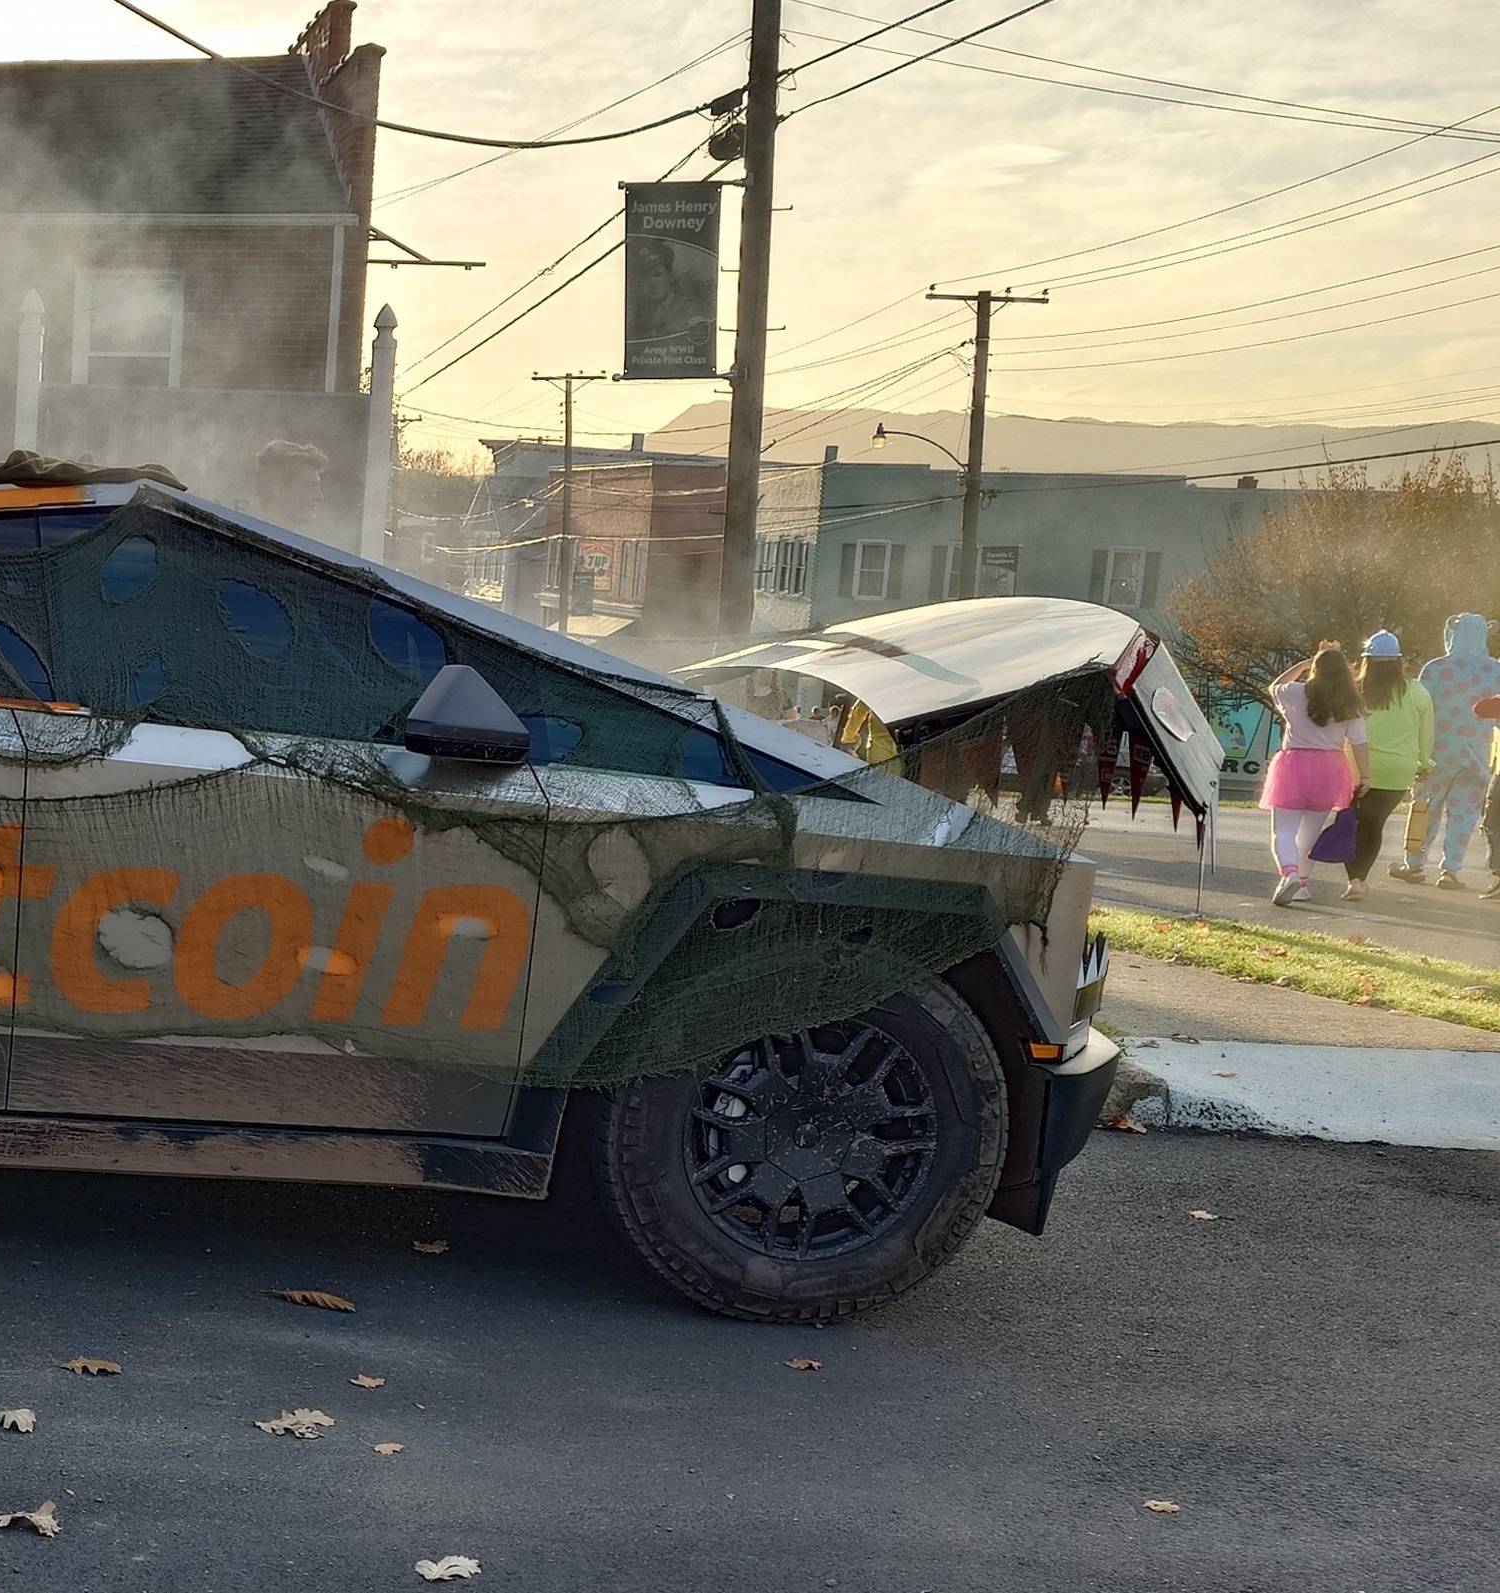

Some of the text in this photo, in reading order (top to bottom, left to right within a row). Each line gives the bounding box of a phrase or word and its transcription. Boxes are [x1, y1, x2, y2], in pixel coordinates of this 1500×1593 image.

[631, 201, 717, 214] James Henry
[643, 216, 706, 232] Downey
[643, 345, 668, 356] Army
[632, 355, 707, 365] Private First Class
